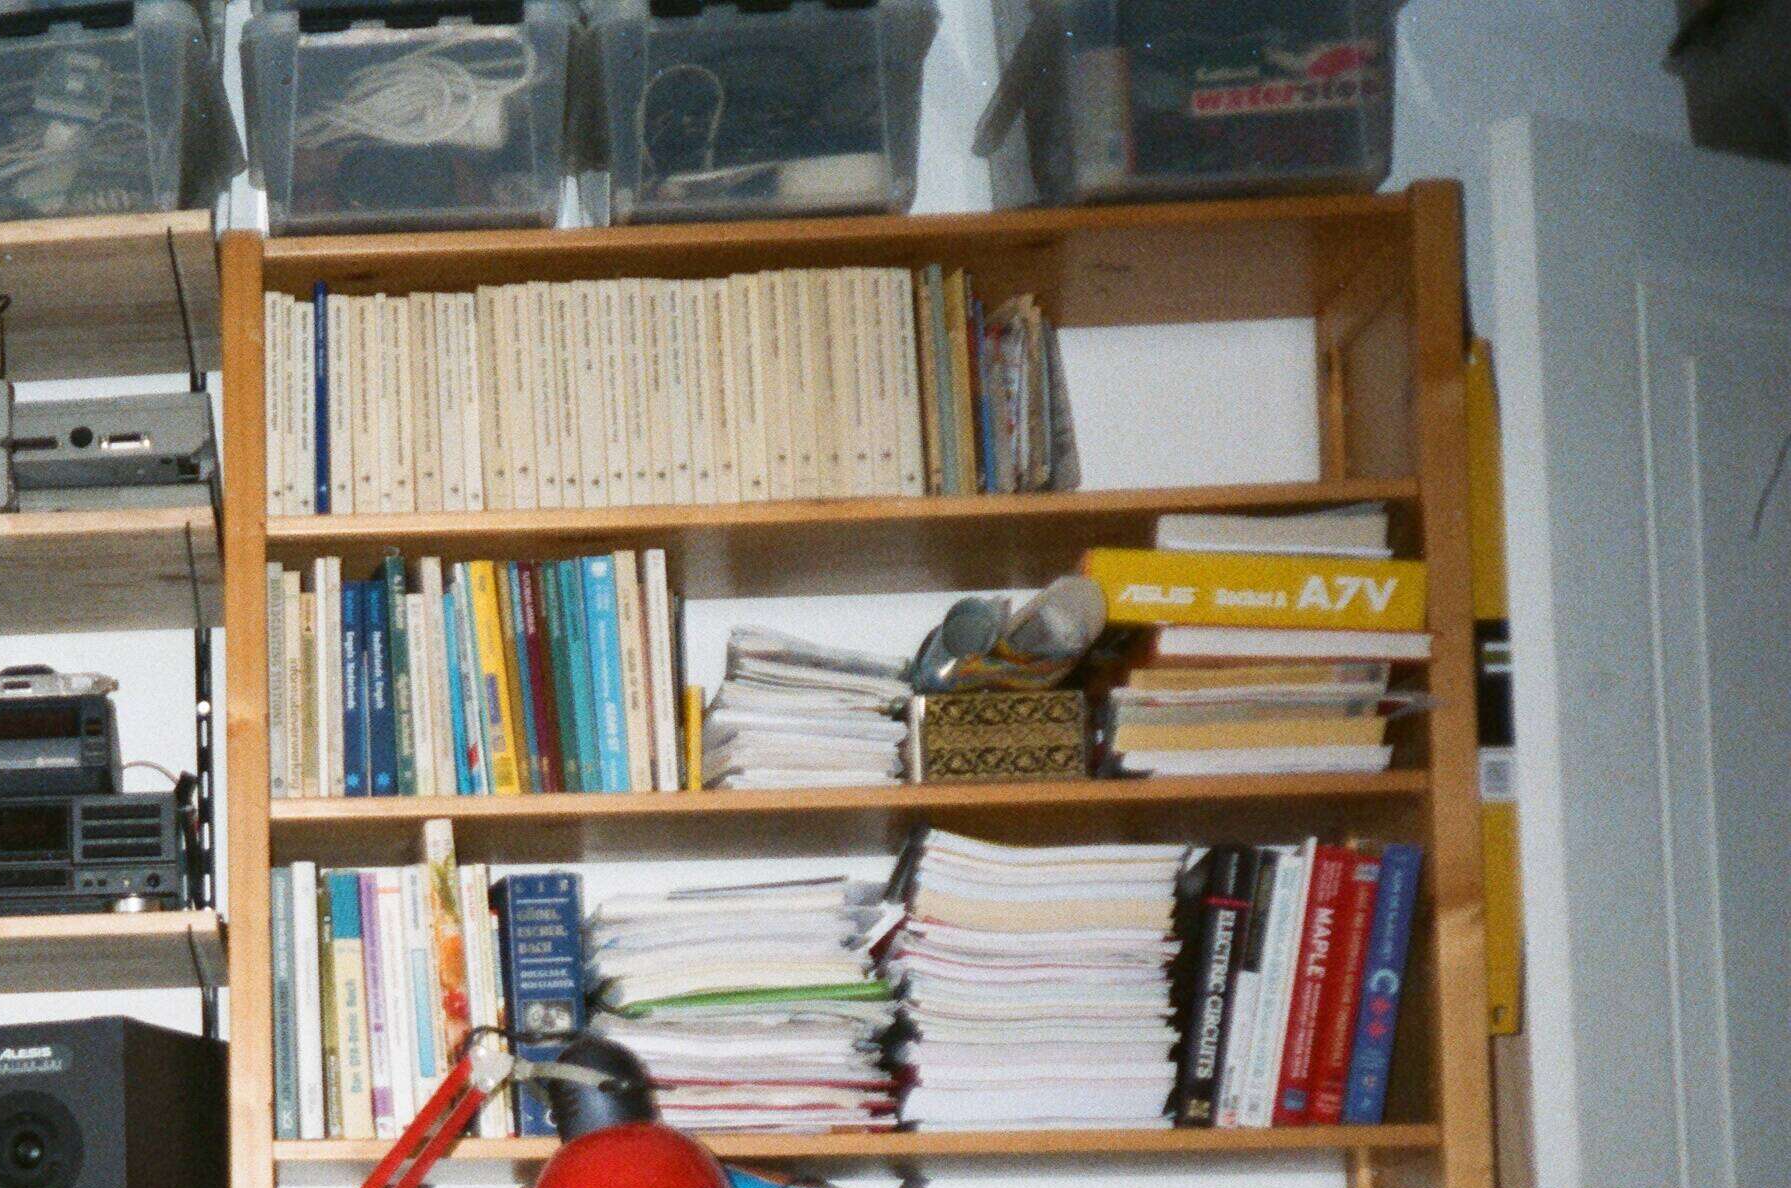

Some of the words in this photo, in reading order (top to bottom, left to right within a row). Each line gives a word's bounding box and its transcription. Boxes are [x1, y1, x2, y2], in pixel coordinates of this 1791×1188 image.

[1118, 584, 1198, 605] ASUS
[1295, 574, 1398, 613] A7V
[271, 670, 283, 727] STATIONS
[289, 657, 301, 790] informatieverwerking
[1208, 909, 1237, 993] ELECTRIC
[1305, 906, 1335, 979] MAPLE
[1196, 995, 1223, 1080] CIRCUITS
